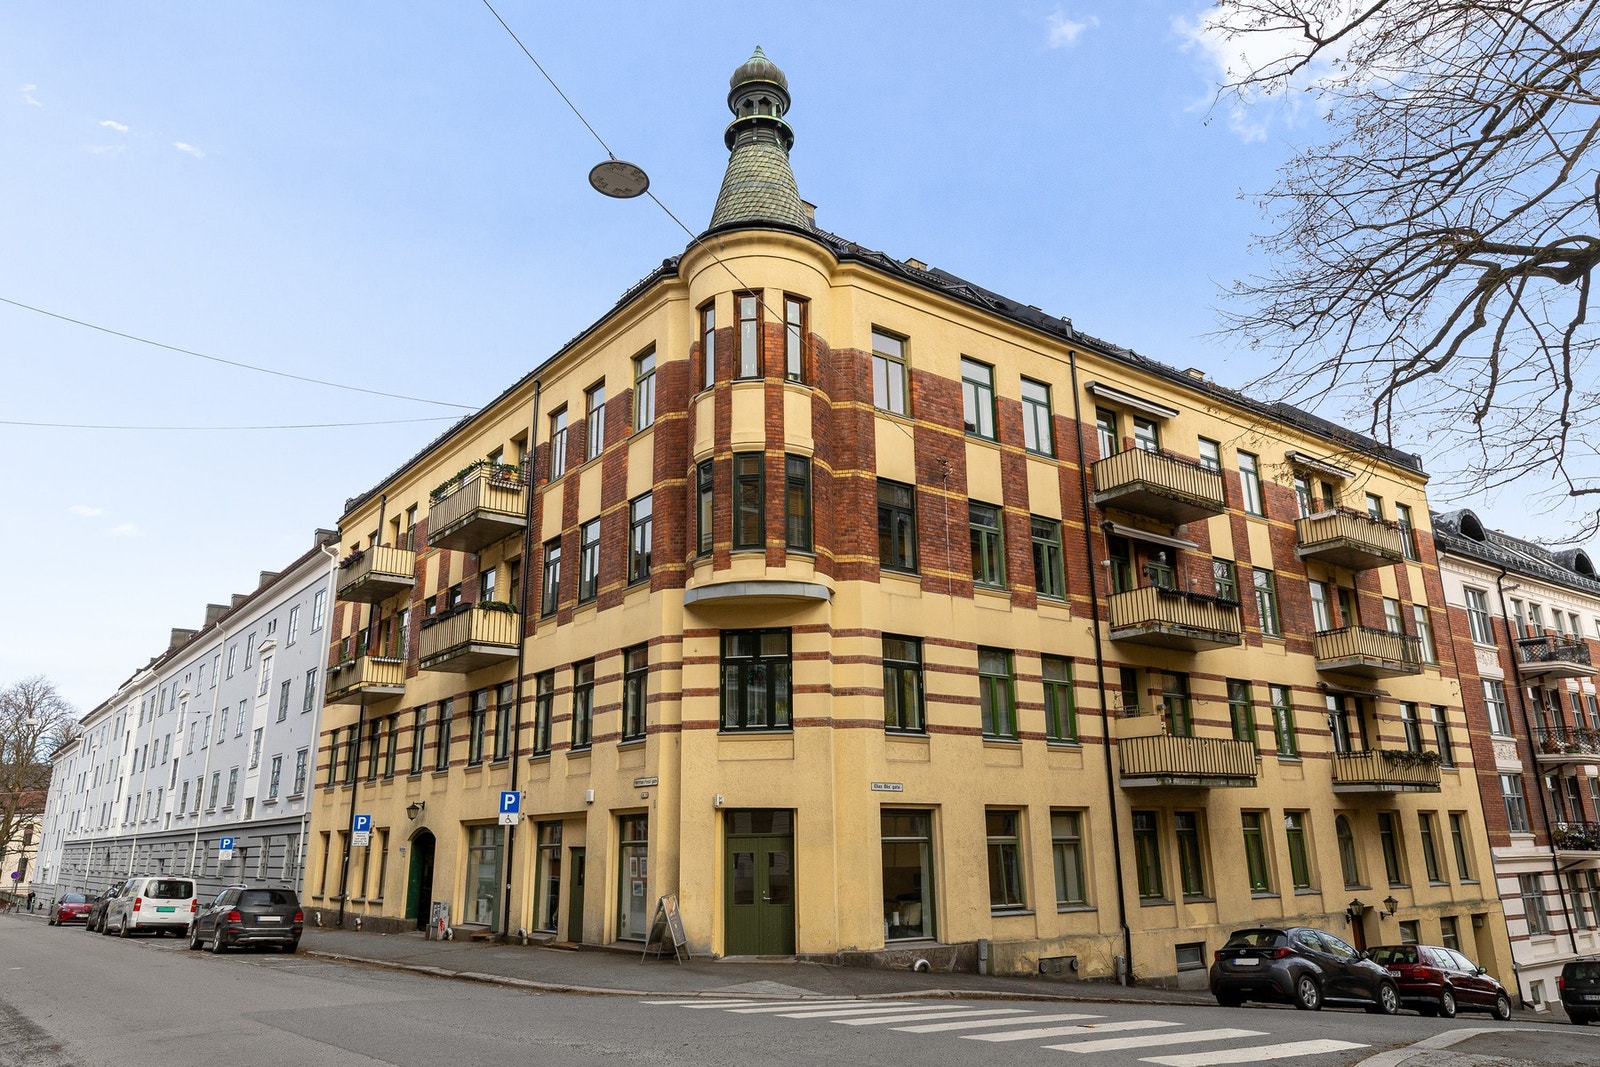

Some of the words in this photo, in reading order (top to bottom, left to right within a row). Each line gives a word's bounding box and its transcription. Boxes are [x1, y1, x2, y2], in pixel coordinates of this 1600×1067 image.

[504, 794, 515, 810] P
[358, 817, 366, 829] P
[223, 839, 230, 848] P
